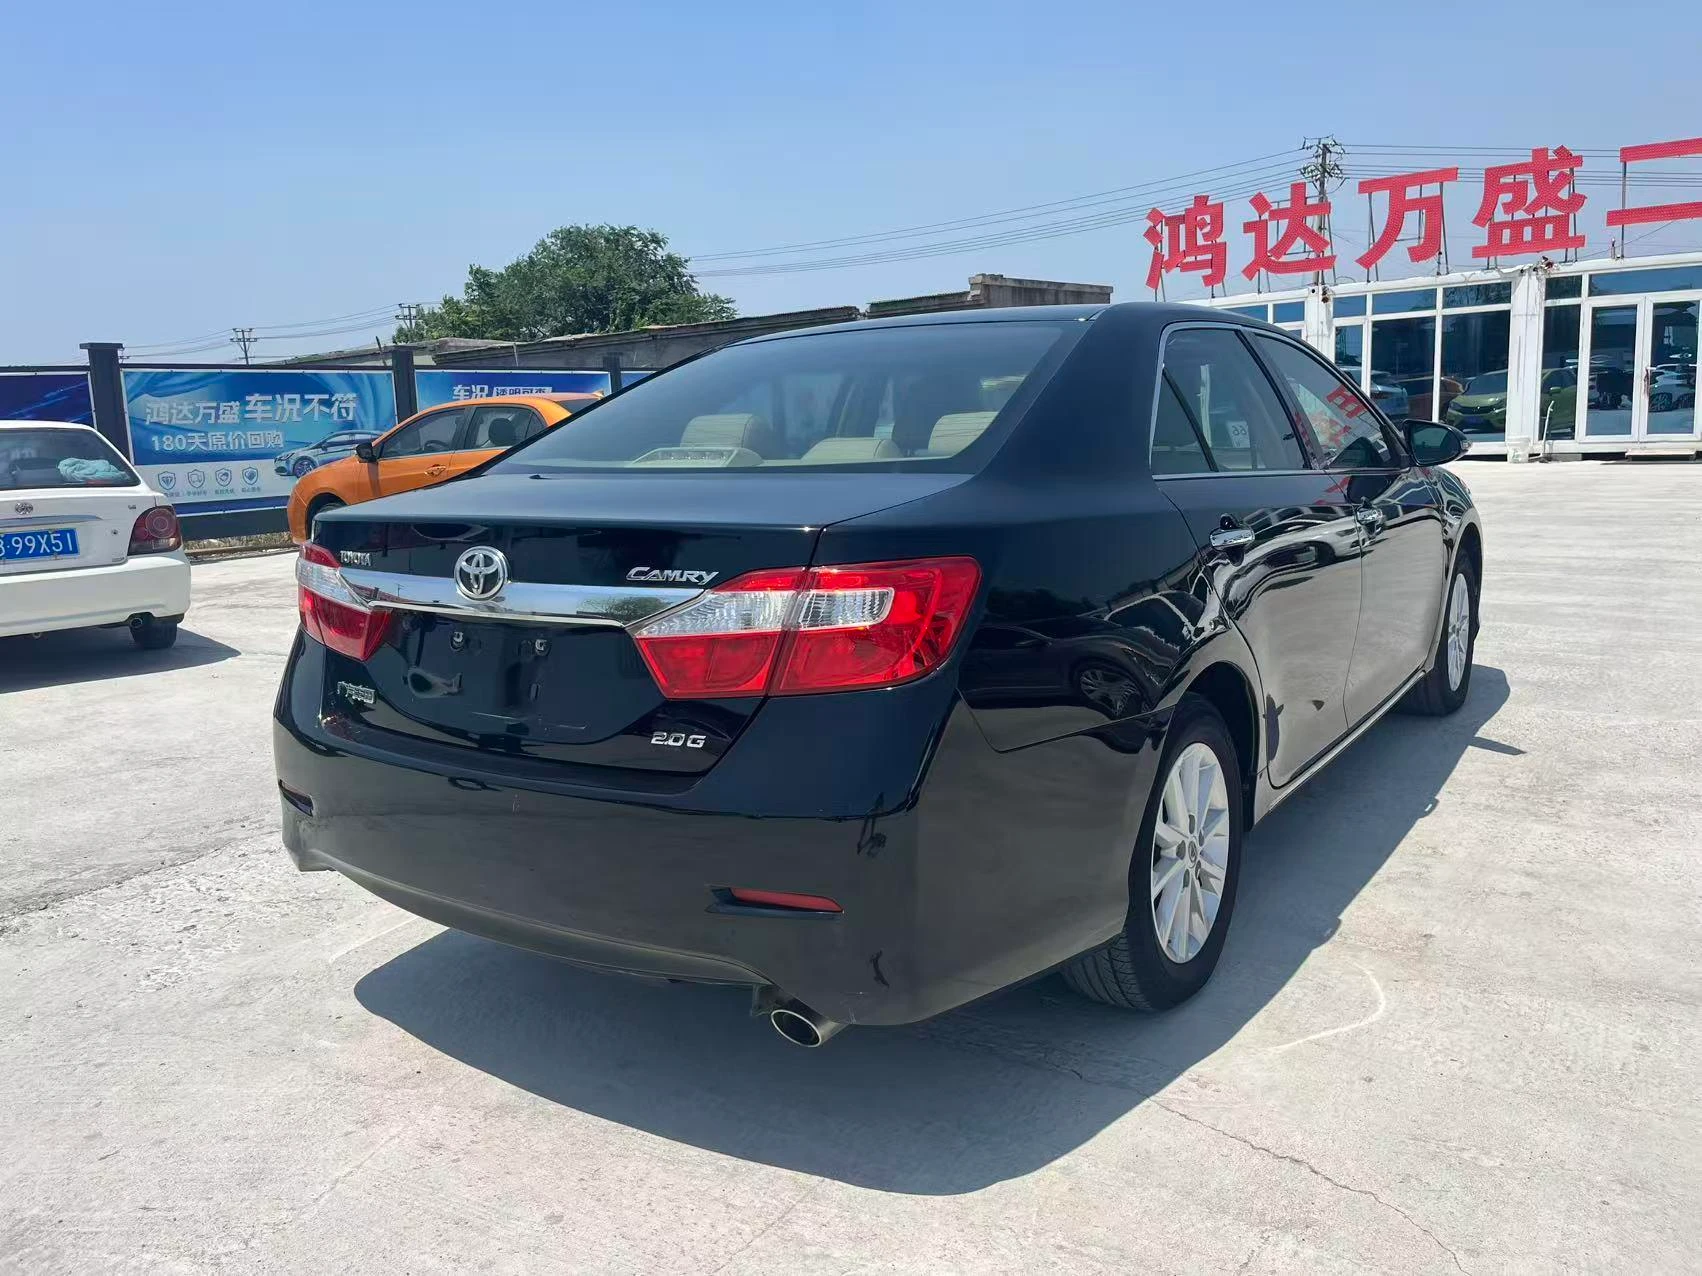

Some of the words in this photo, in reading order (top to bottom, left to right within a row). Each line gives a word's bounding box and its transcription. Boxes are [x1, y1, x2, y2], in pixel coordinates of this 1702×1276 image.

[453, 385, 488, 400] 车况
[145, 401, 241, 425] 鸿达万盛
[244, 393, 358, 423] 车况不符
[151, 430, 285, 452] 180天原价回购
[340, 550, 371, 567] TOYOTA
[626, 566, 719, 586] CAMRY
